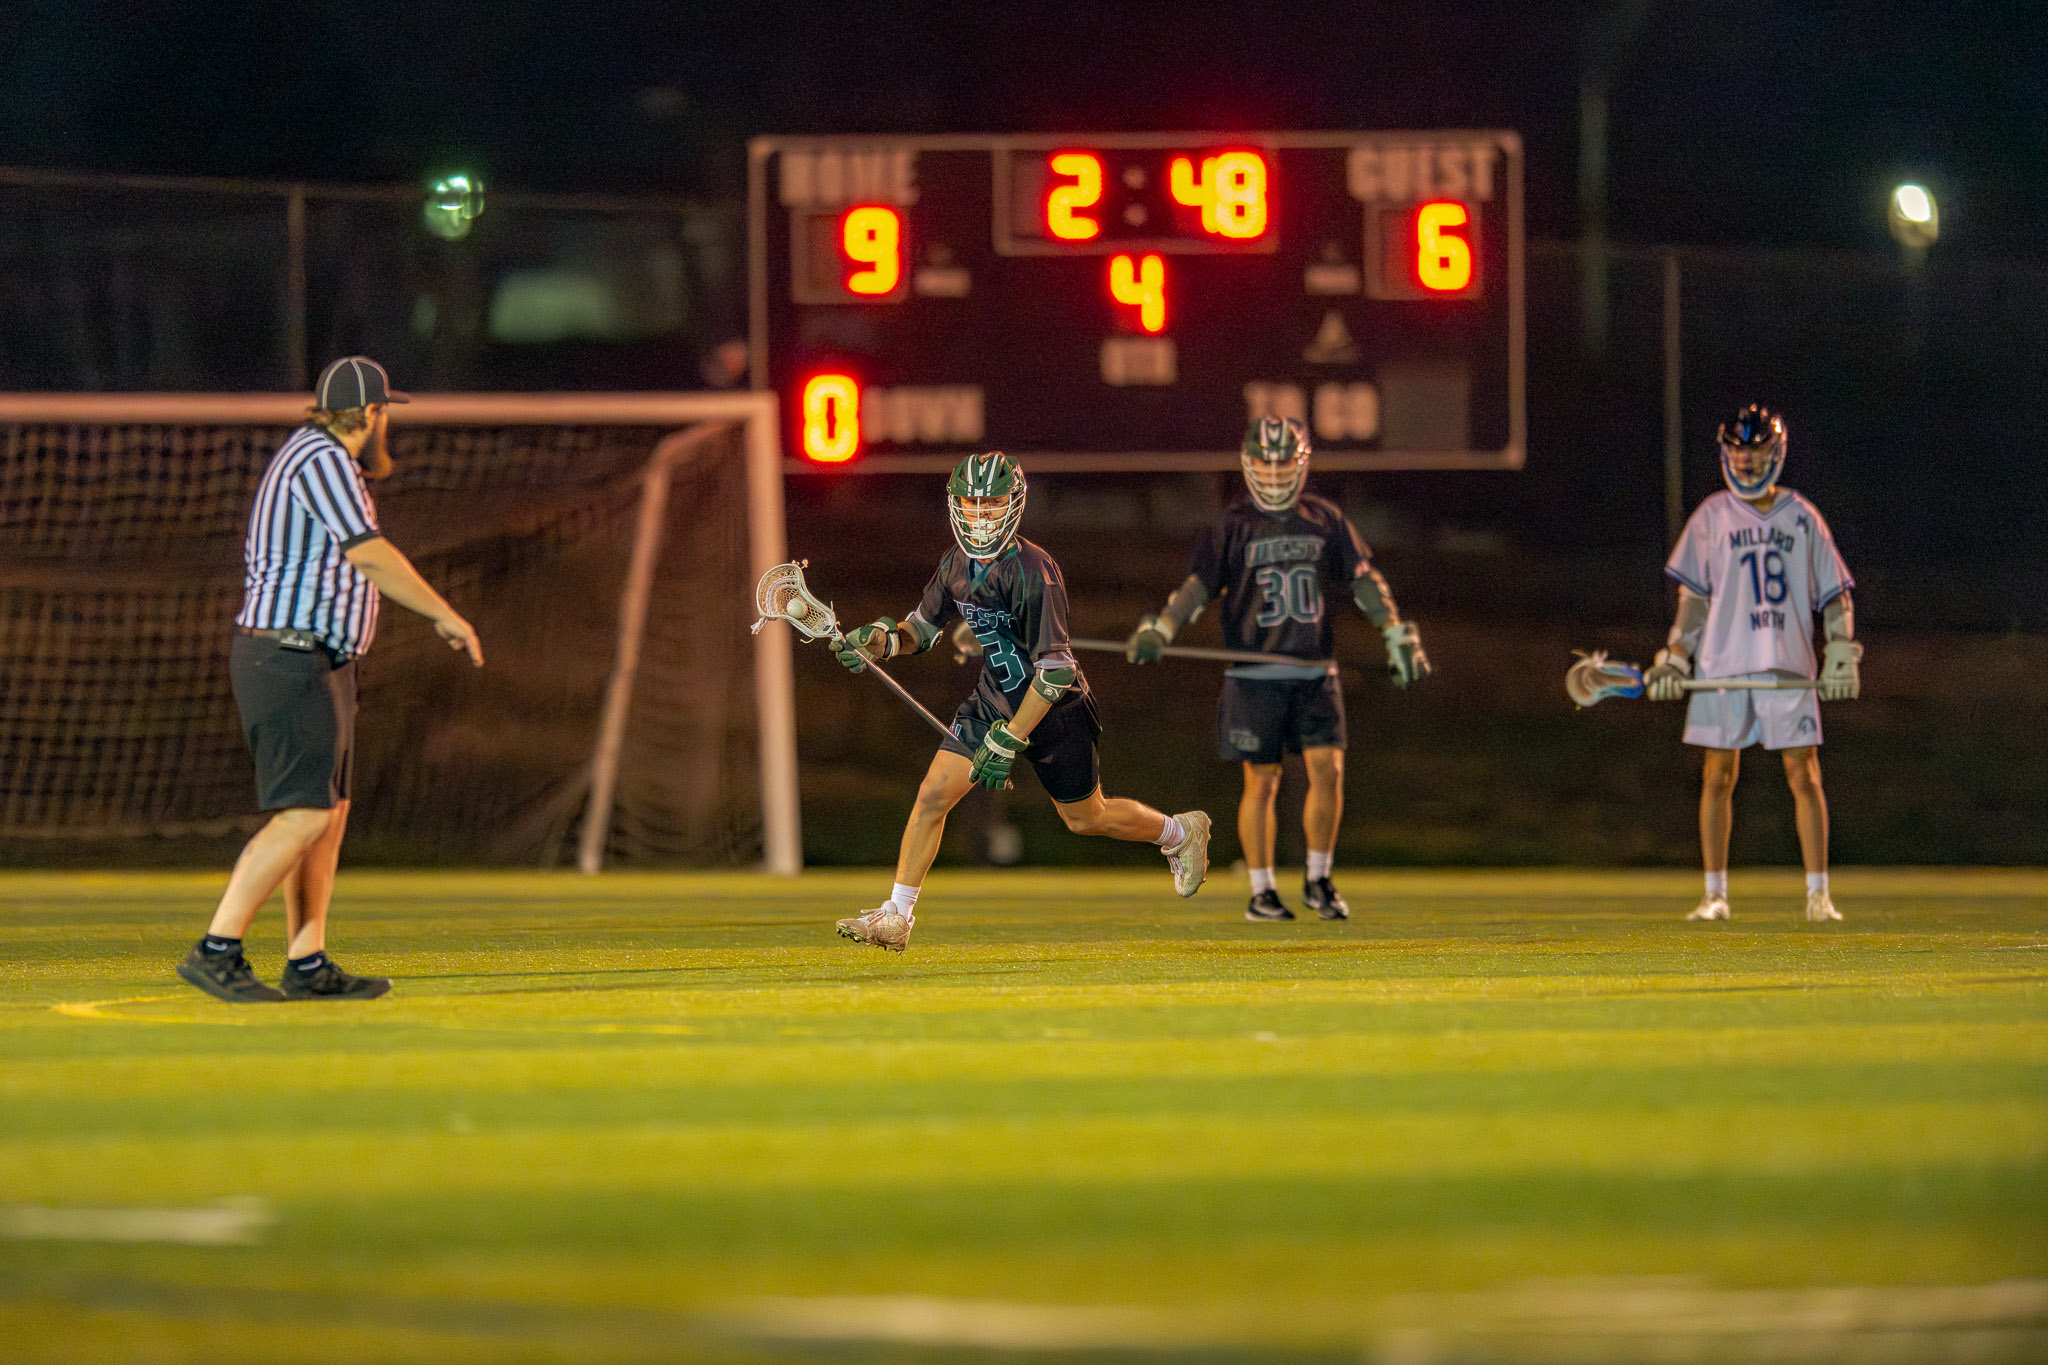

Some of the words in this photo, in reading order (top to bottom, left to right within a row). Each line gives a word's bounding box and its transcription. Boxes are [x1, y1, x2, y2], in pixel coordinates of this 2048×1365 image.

[842, 205, 901, 296] 9
[1416, 201, 1472, 291] 6
[1108, 253, 1166, 333] 4
[802, 372, 860, 463] 0
[1729, 526, 1795, 553] MILLARD
[1256, 567, 1323, 628] 30
[1740, 551, 1788, 606] 18
[955, 600, 1014, 629] EST
[1750, 610, 1785, 631] NRTH
[976, 630, 1026, 692] 3
